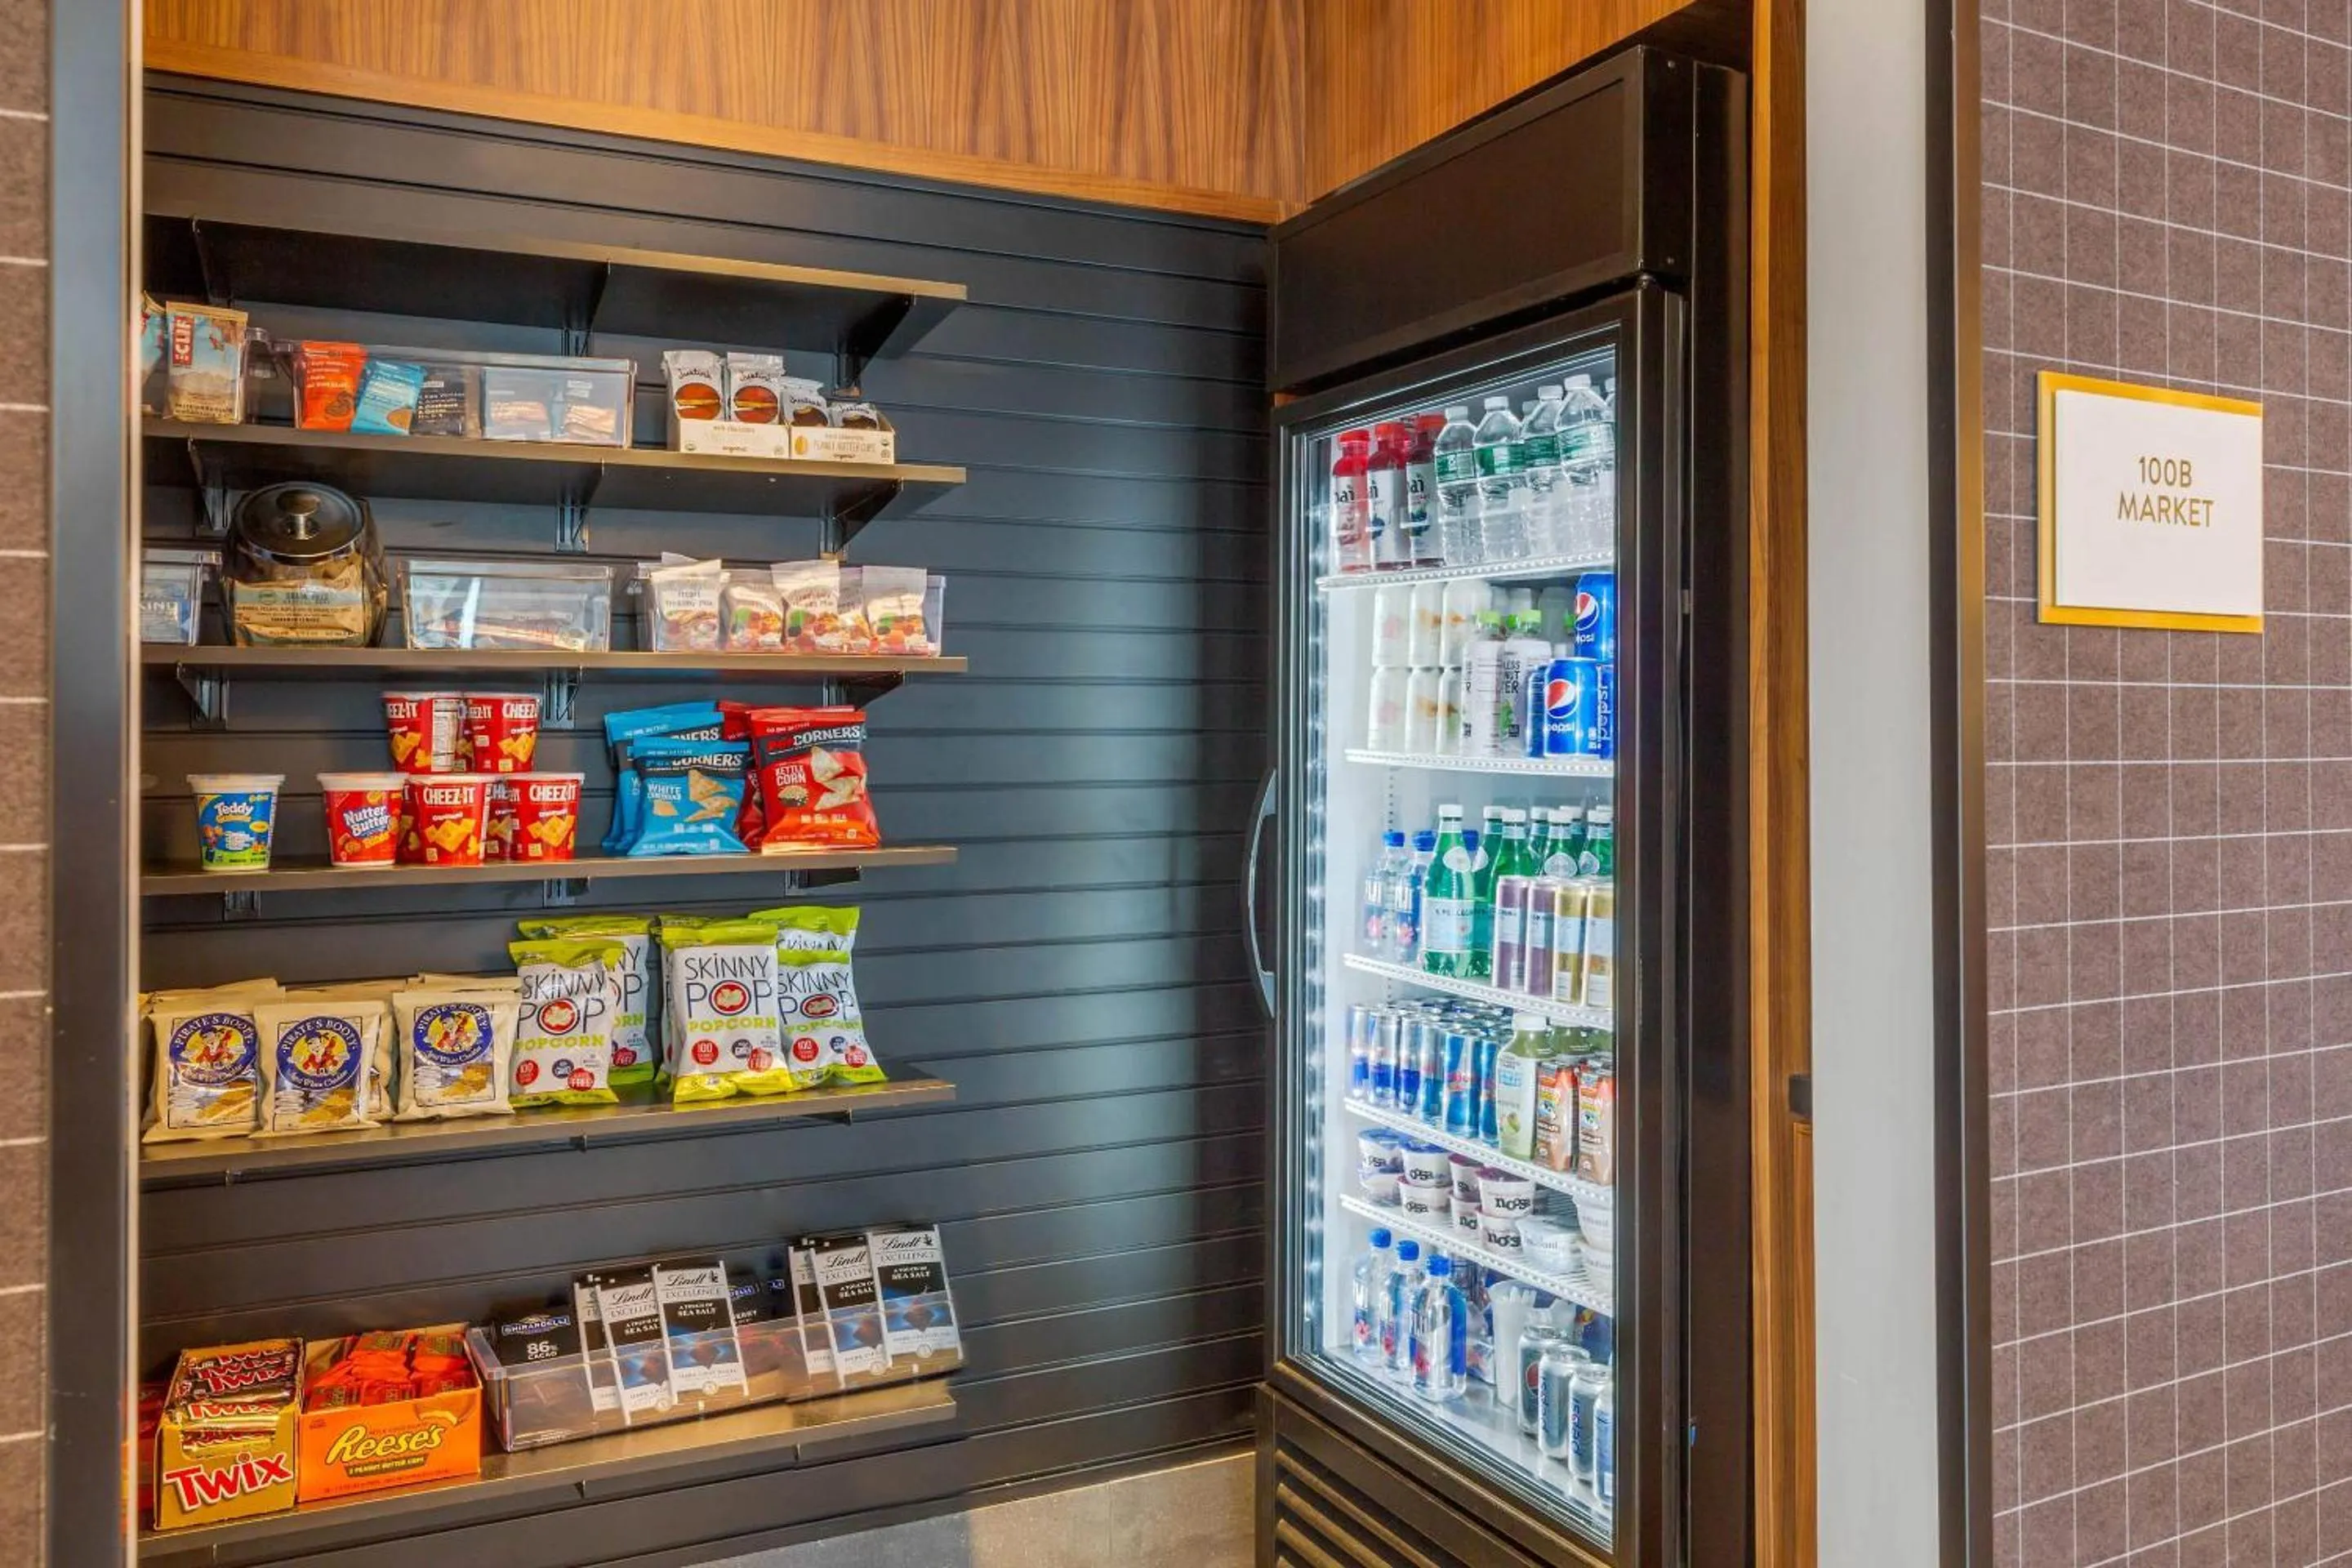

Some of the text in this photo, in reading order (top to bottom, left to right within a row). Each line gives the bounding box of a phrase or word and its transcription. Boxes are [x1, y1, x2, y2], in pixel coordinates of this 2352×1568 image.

[175, 318, 191, 354] CLIF
[2138, 456, 2193, 488] 100B
[1411, 473, 1425, 493] ai
[2118, 492, 2215, 528] MARKET
[776, 764, 804, 776] KETTLE
[647, 783, 682, 795] WHITE
[776, 774, 806, 786] CORN
[423, 786, 475, 805] CHEEZ-IT
[528, 783, 577, 803] CHEEZ-IT
[213, 801, 255, 817] Teddy
[343, 805, 388, 826] Nutter
[351, 815, 390, 837] Butter
[684, 952, 769, 981] SKINNY
[522, 969, 605, 1000] SKINNY
[777, 971, 849, 995] SKINNY
[686, 980, 773, 1019] POP
[777, 990, 855, 1025] POP
[516, 996, 606, 1040] POP
[687, 1017, 777, 1033] POPCORN
[326, 1019, 359, 1047] BOOTY
[514, 1034, 604, 1051] POPCORN
[882, 1235, 921, 1250] Lindt
[826, 1250, 866, 1267] Lindt
[666, 1271, 707, 1287] Lindt
[892, 1271, 930, 1281] SEA SALT
[612, 1286, 653, 1304] Lindt
[858, 1286, 873, 1295] SAL
[677, 1307, 716, 1317] SEA SALT
[643, 1322, 659, 1333] SAL
[528, 1351, 558, 1361] CACAO
[208, 1366, 291, 1393] Twix
[188, 1402, 279, 1420] Twix
[326, 1424, 446, 1465] Reese's
[164, 1450, 293, 1511] Twix
